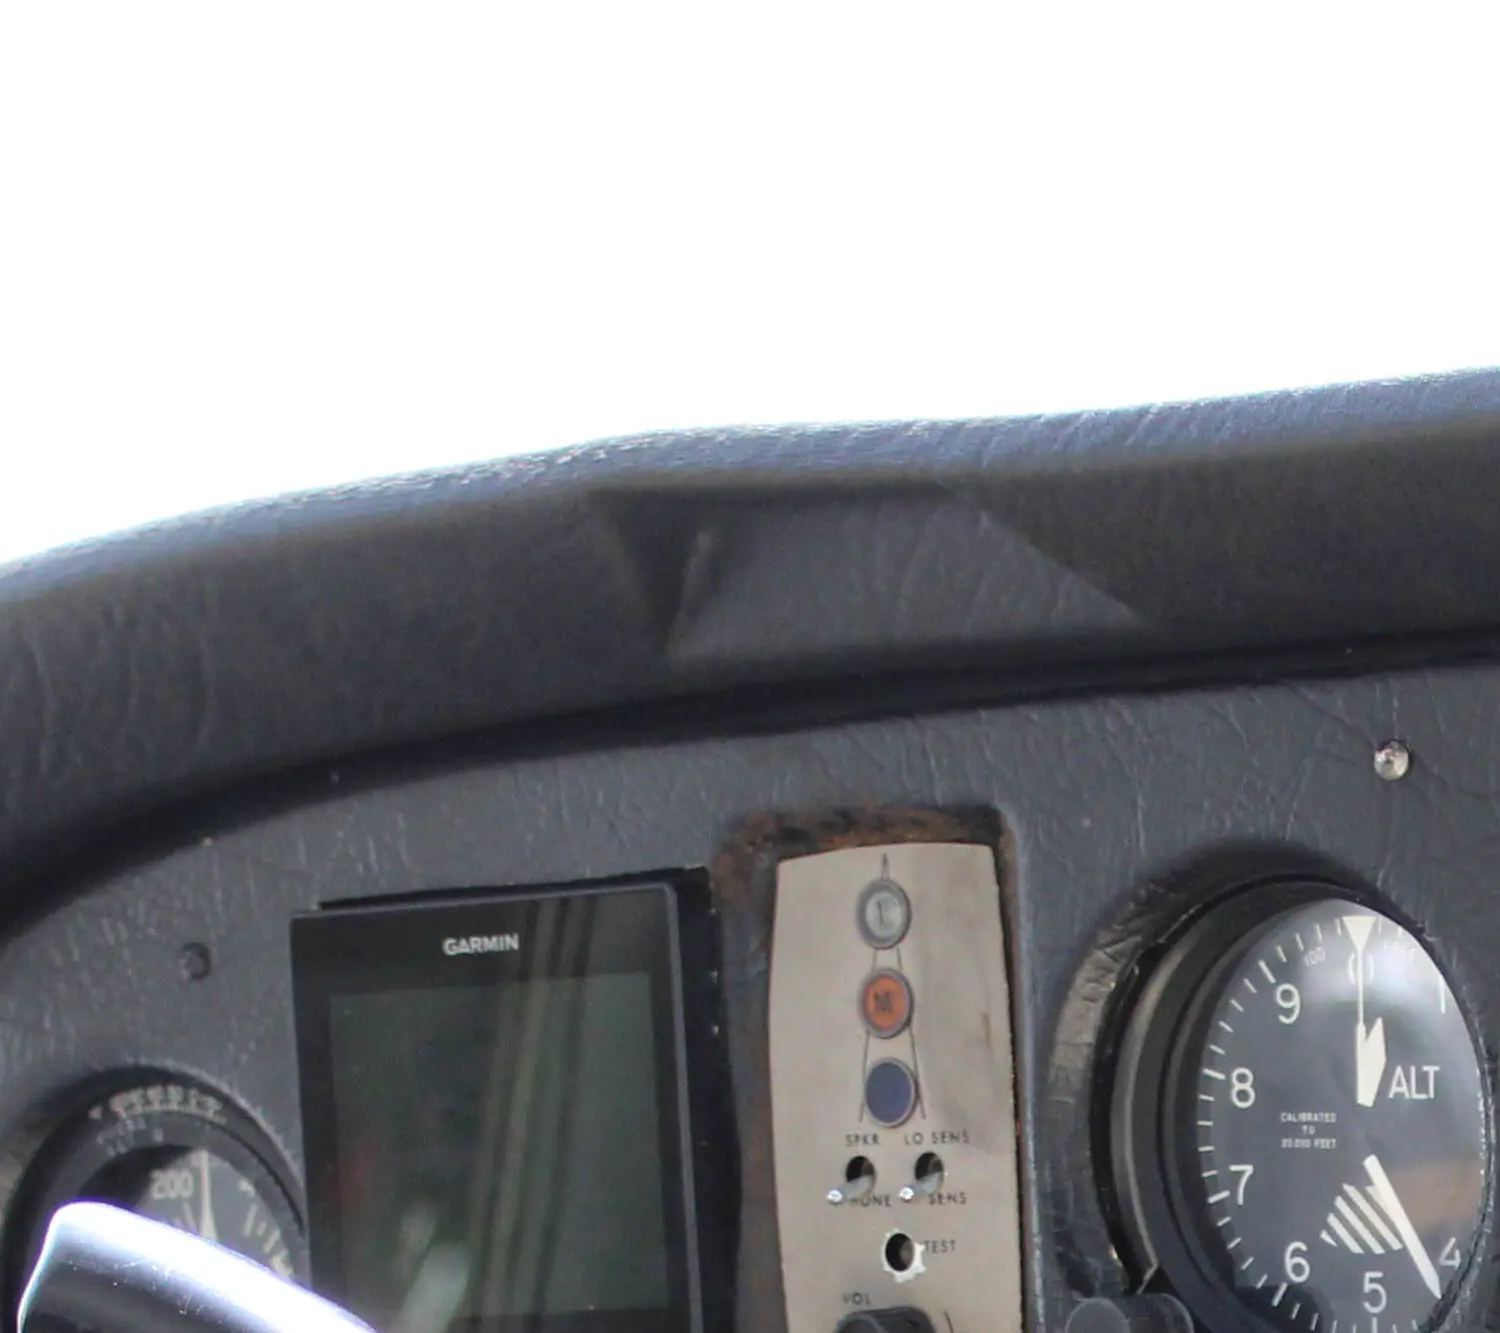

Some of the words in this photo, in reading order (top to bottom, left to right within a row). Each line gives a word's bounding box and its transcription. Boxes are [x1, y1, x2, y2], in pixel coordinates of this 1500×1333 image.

[444, 933, 519, 955] GARMIN
[1276, 983, 1299, 1023] 9
[1230, 1068, 1255, 1109] 8
[1389, 1066, 1439, 1099] ALT
[1230, 1166, 1253, 1204] 7
[1285, 1242, 1310, 1282] 6
[1364, 1272, 1385, 1313] 5
